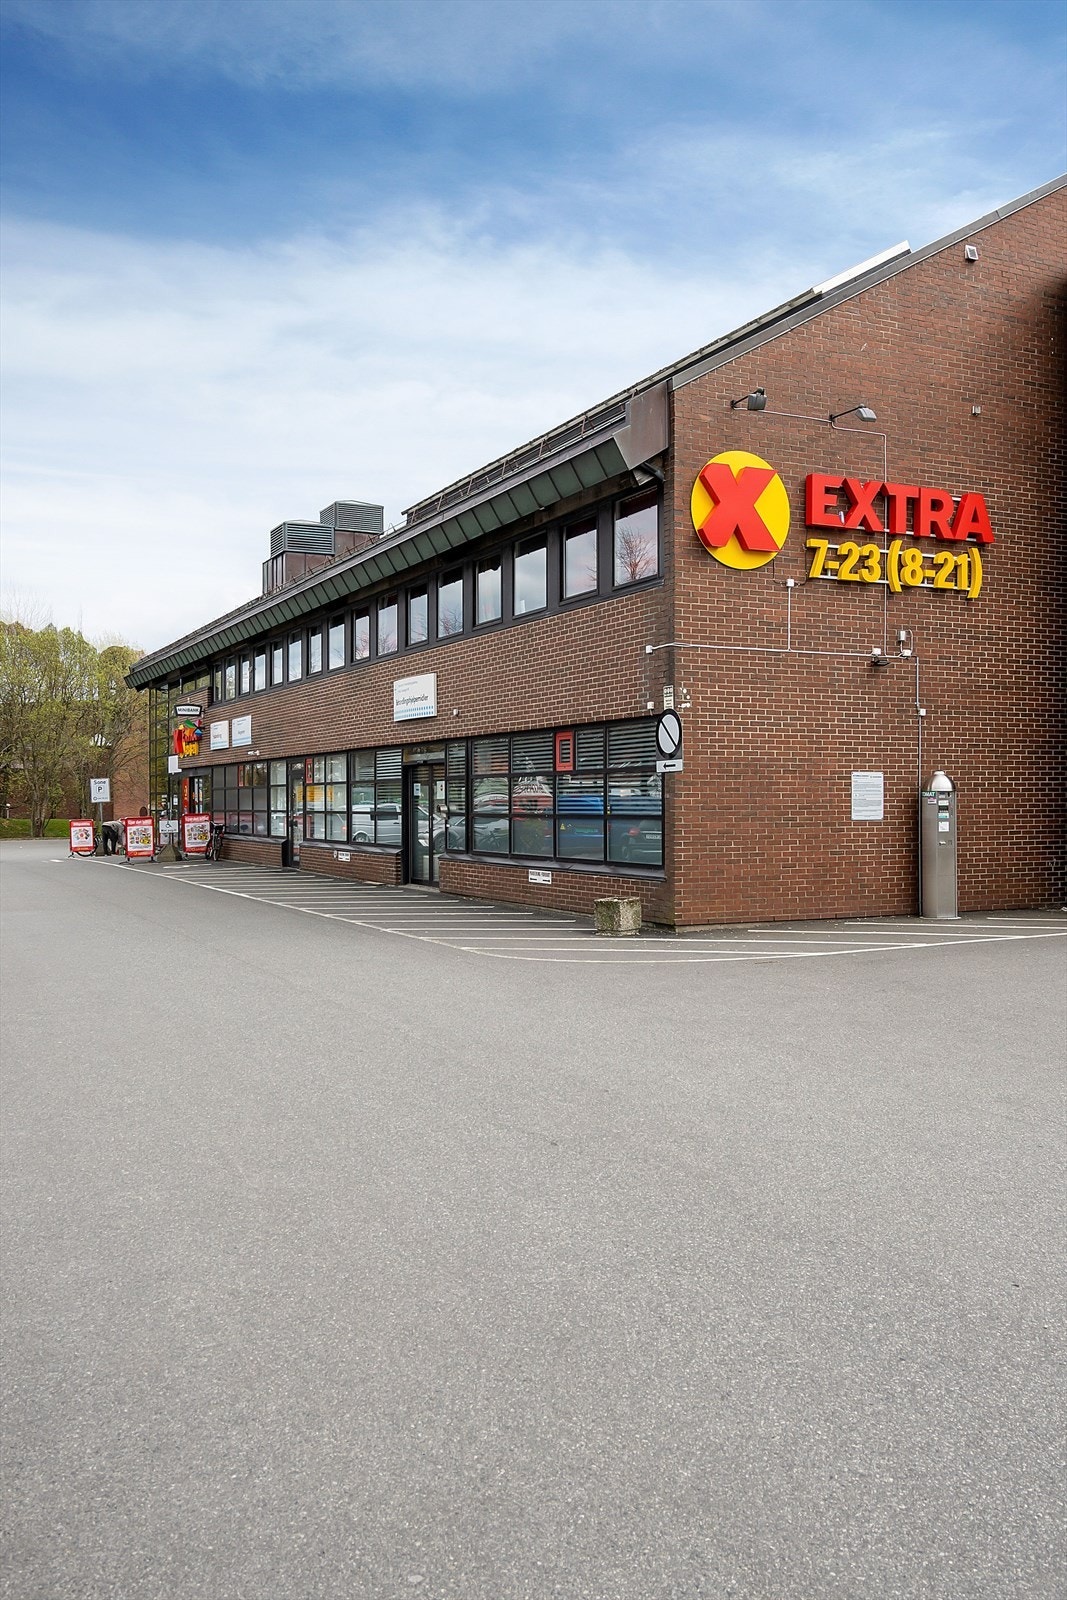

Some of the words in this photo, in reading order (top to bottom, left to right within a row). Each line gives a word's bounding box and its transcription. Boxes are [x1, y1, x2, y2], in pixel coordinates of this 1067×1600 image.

[698, 463, 780, 552] X
[805, 473, 995, 544] EXTRA
[806, 538, 882, 583] 7-23
[887, 539, 983, 599] (8-21)
